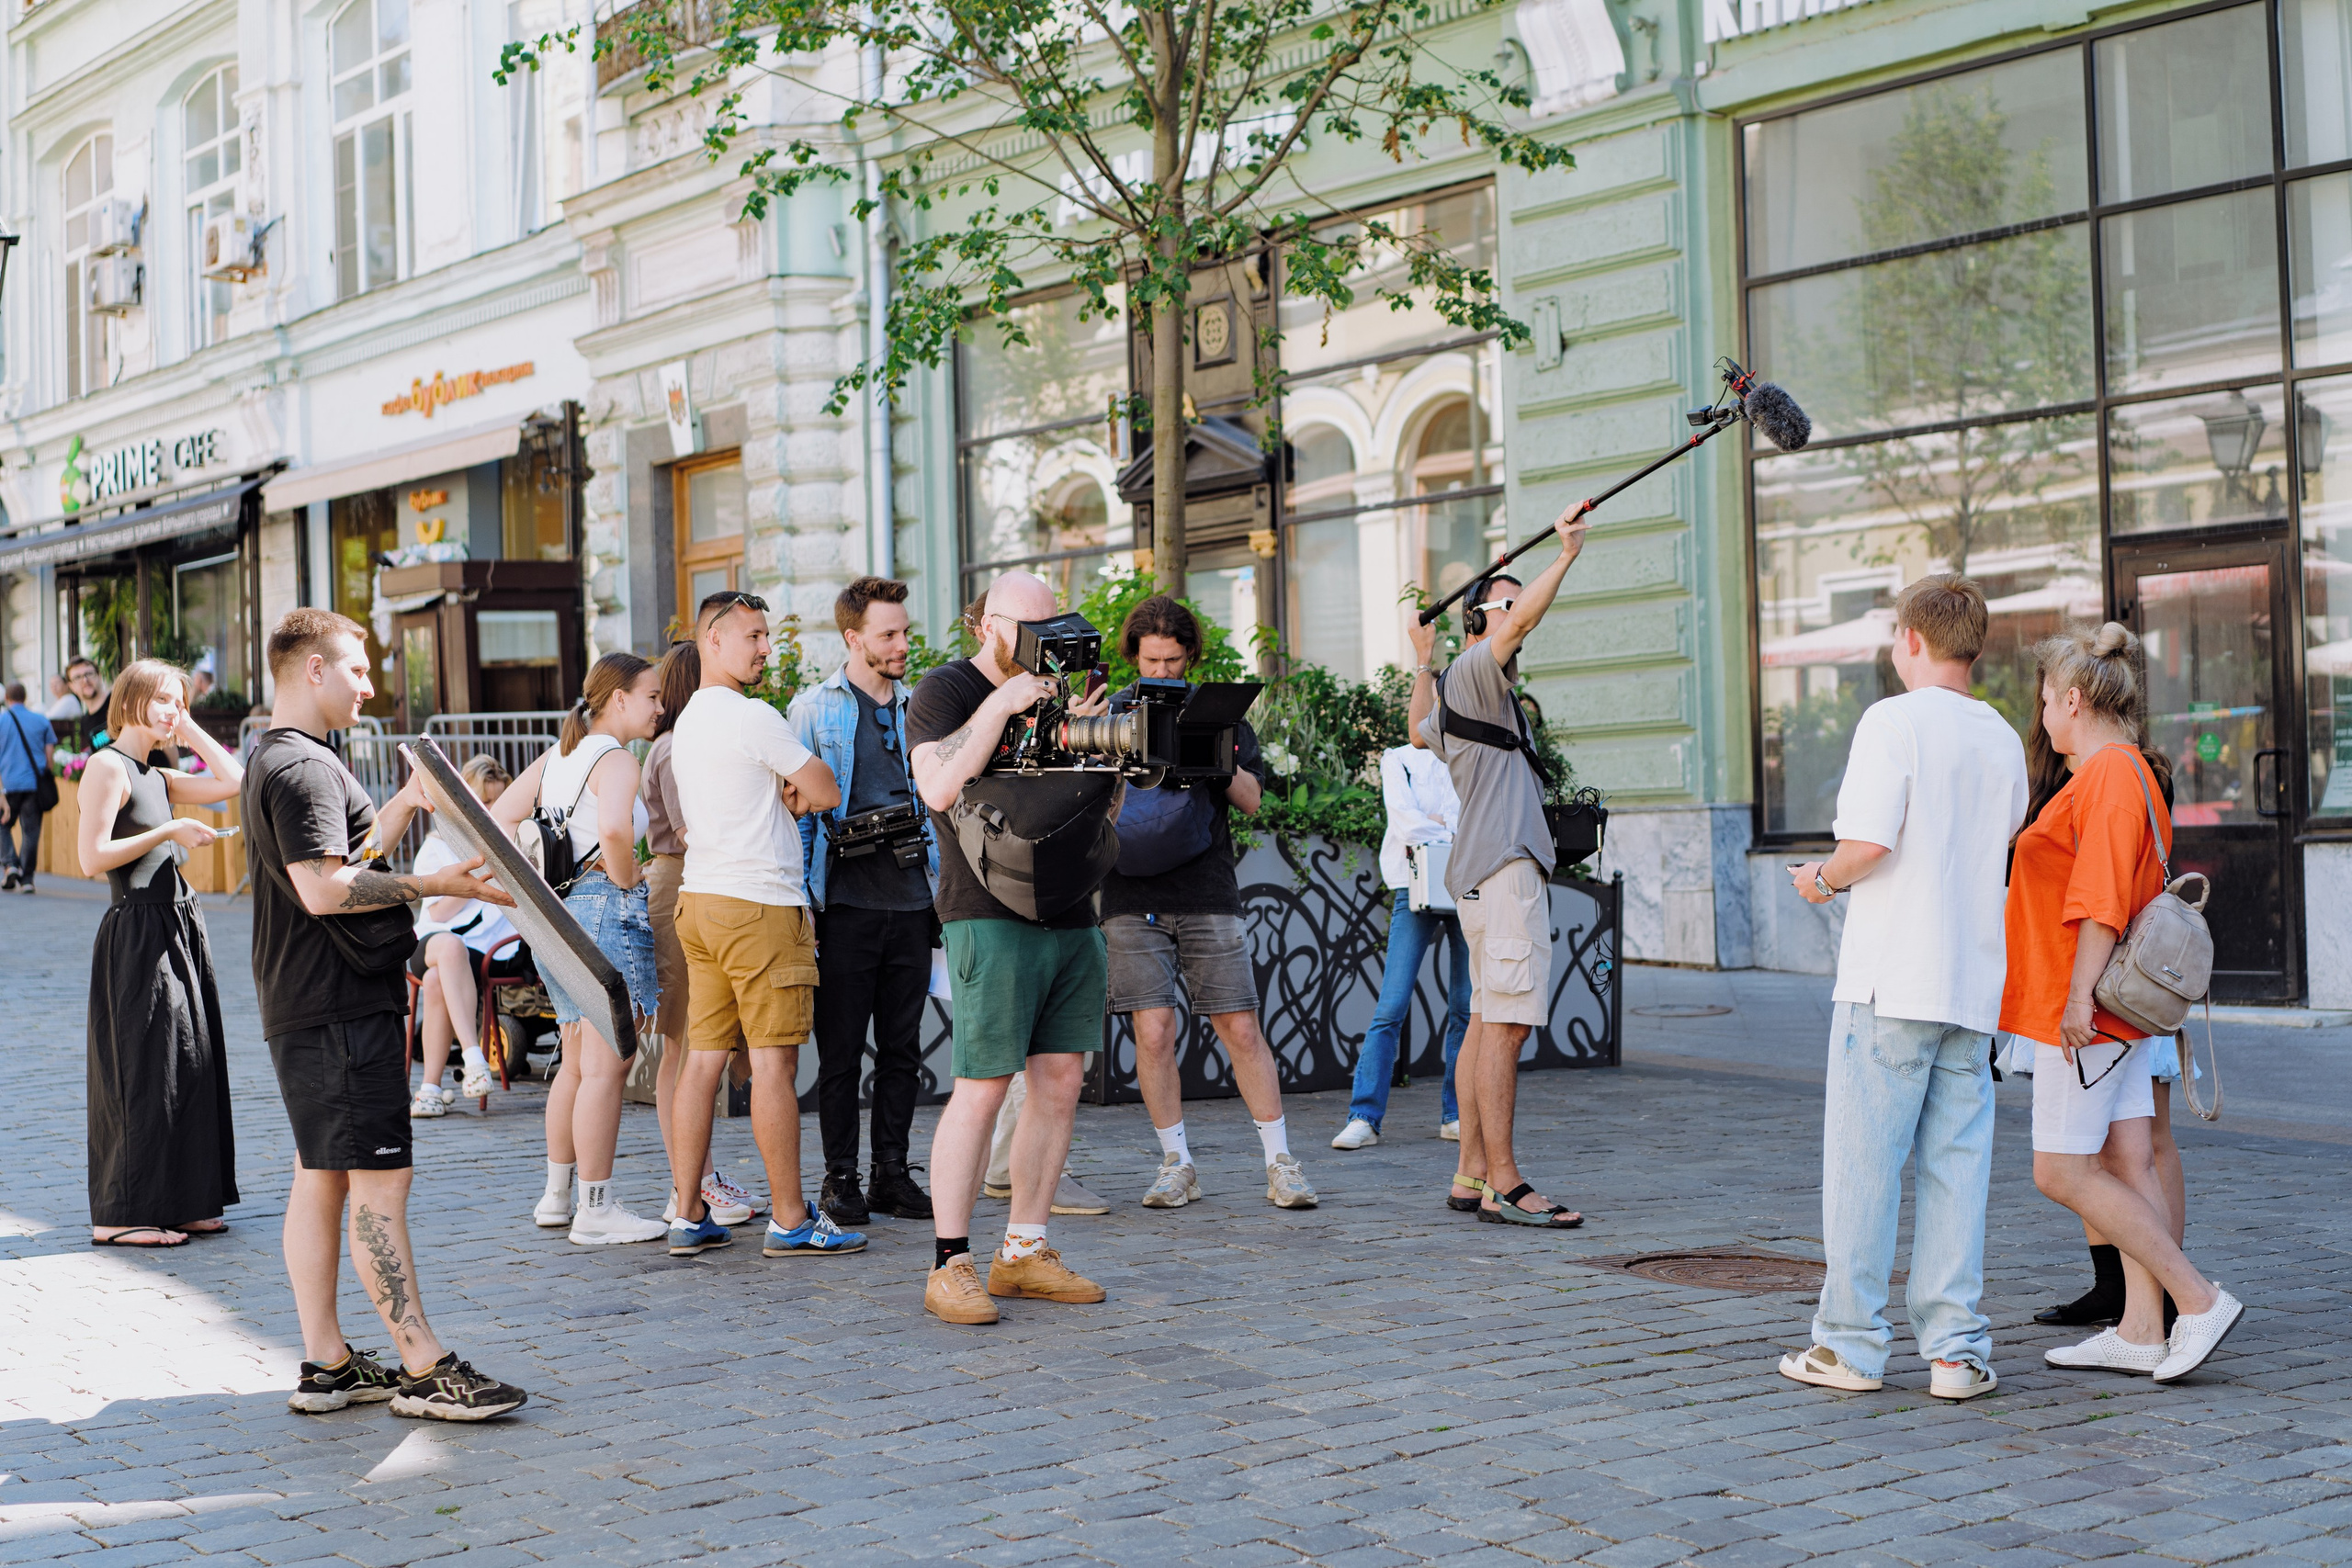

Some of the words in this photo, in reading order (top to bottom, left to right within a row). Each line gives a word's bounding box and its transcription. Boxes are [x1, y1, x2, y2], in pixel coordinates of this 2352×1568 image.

[411, 370, 481, 419] бублик
[90, 438, 161, 501] PRIME
[174, 429, 225, 469] CAFE
